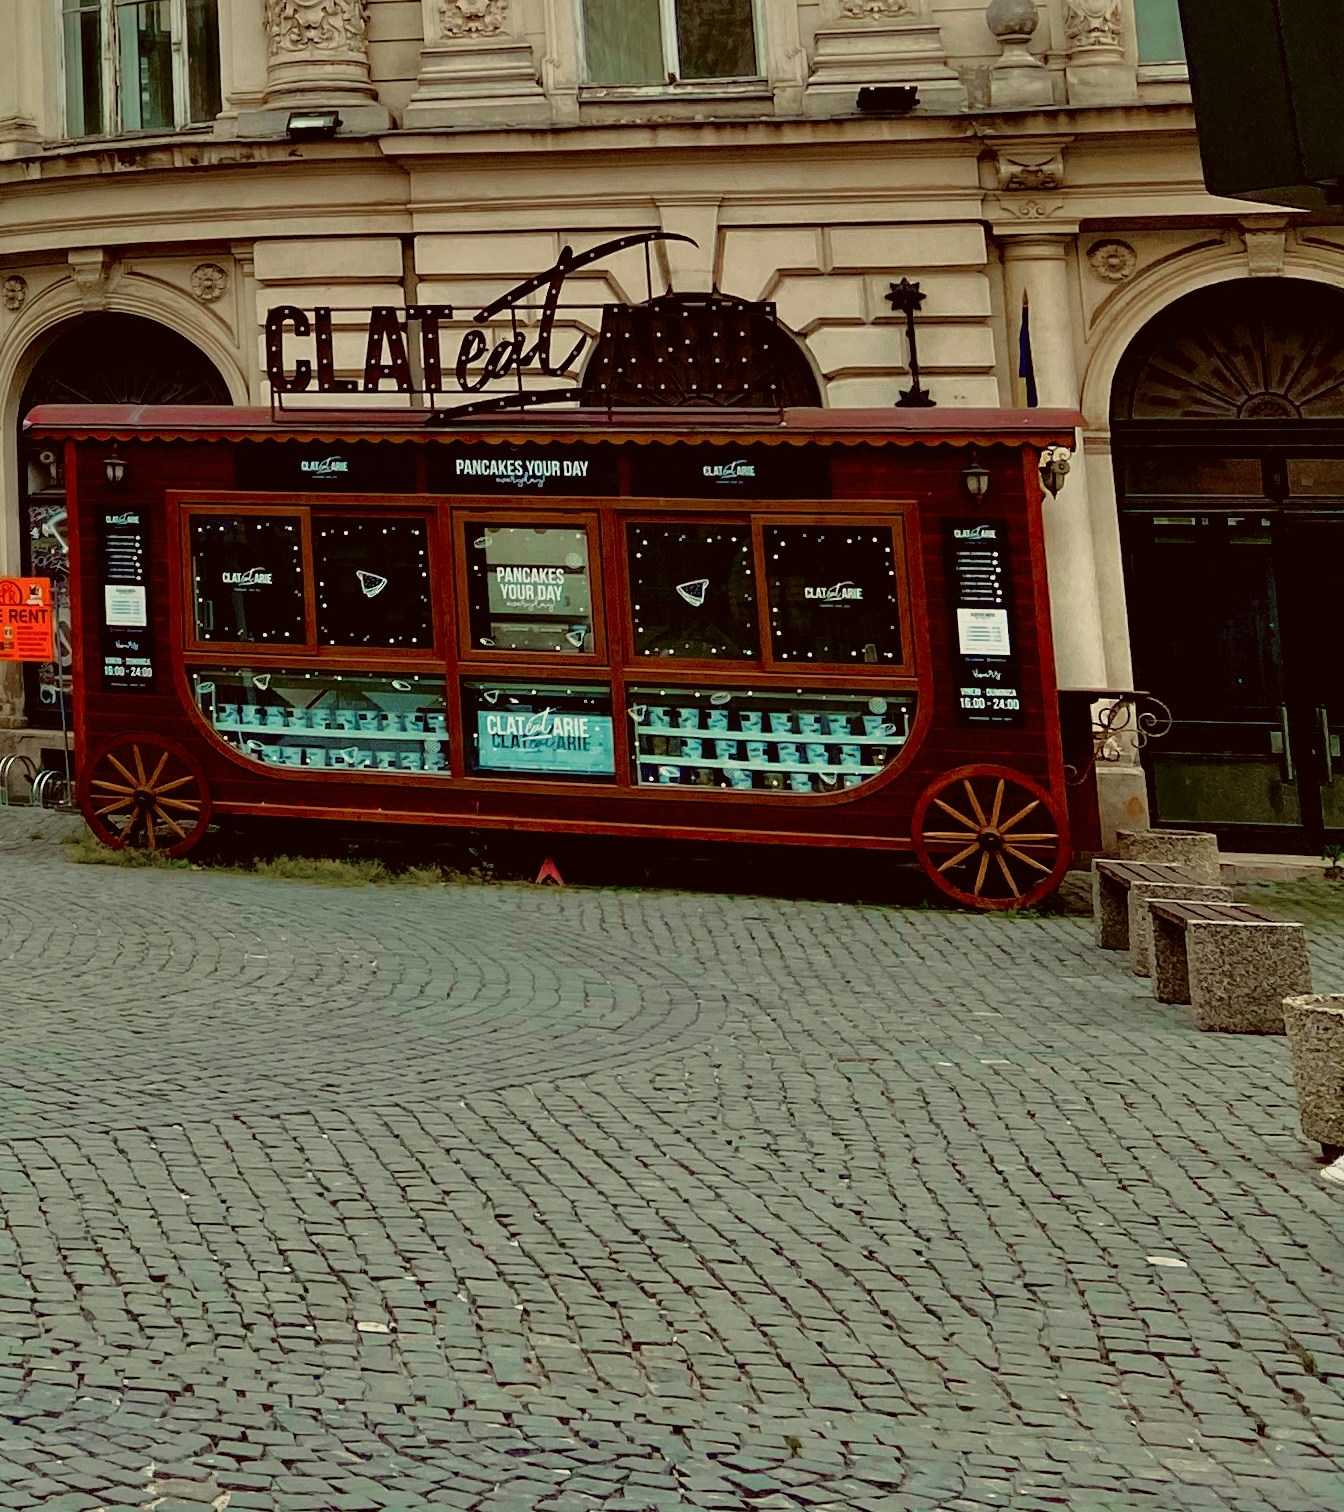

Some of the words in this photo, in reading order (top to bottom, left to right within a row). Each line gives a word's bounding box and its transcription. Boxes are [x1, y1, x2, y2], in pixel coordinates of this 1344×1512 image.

[455, 459, 523, 476] PANCAKES
[525, 460, 561, 476] YOUR
[563, 460, 589, 477] DAY
[496, 567, 565, 585] PANCAKES
[500, 584, 534, 600] YOUR
[537, 585, 562, 601] DAY
[8, 608, 49, 624] RENT
[960, 697, 986, 709] 16:00
[993, 698, 1020, 710] 24:00
